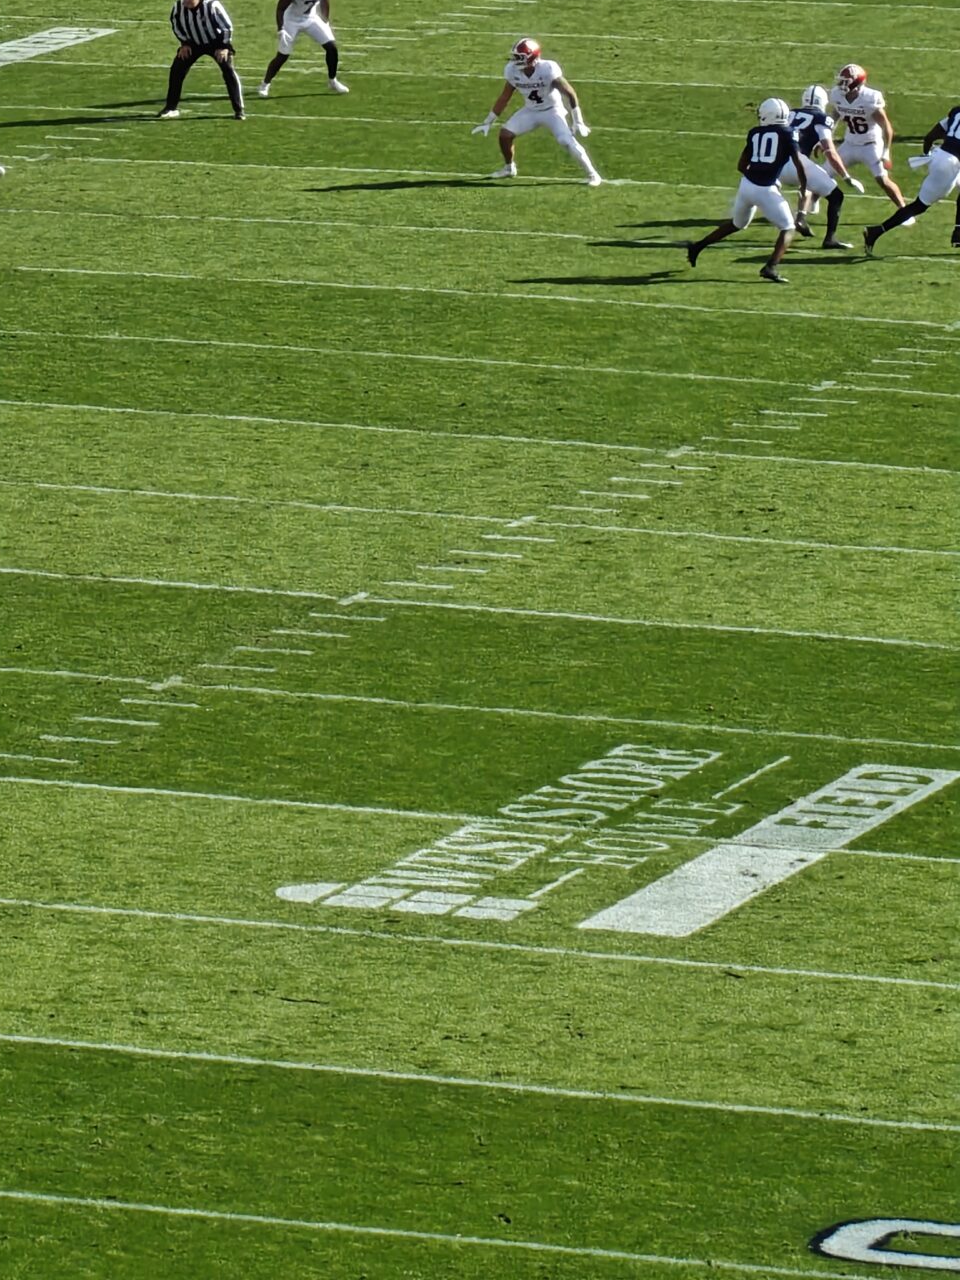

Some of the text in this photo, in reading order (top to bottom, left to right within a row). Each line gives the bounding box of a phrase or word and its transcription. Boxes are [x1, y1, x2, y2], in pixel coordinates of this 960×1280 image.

[528, 89, 544, 104] 4
[843, 115, 869, 134] 16
[946, 113, 960, 140] 1
[751, 132, 779, 164] 10
[774, 770, 936, 830] FIELD
